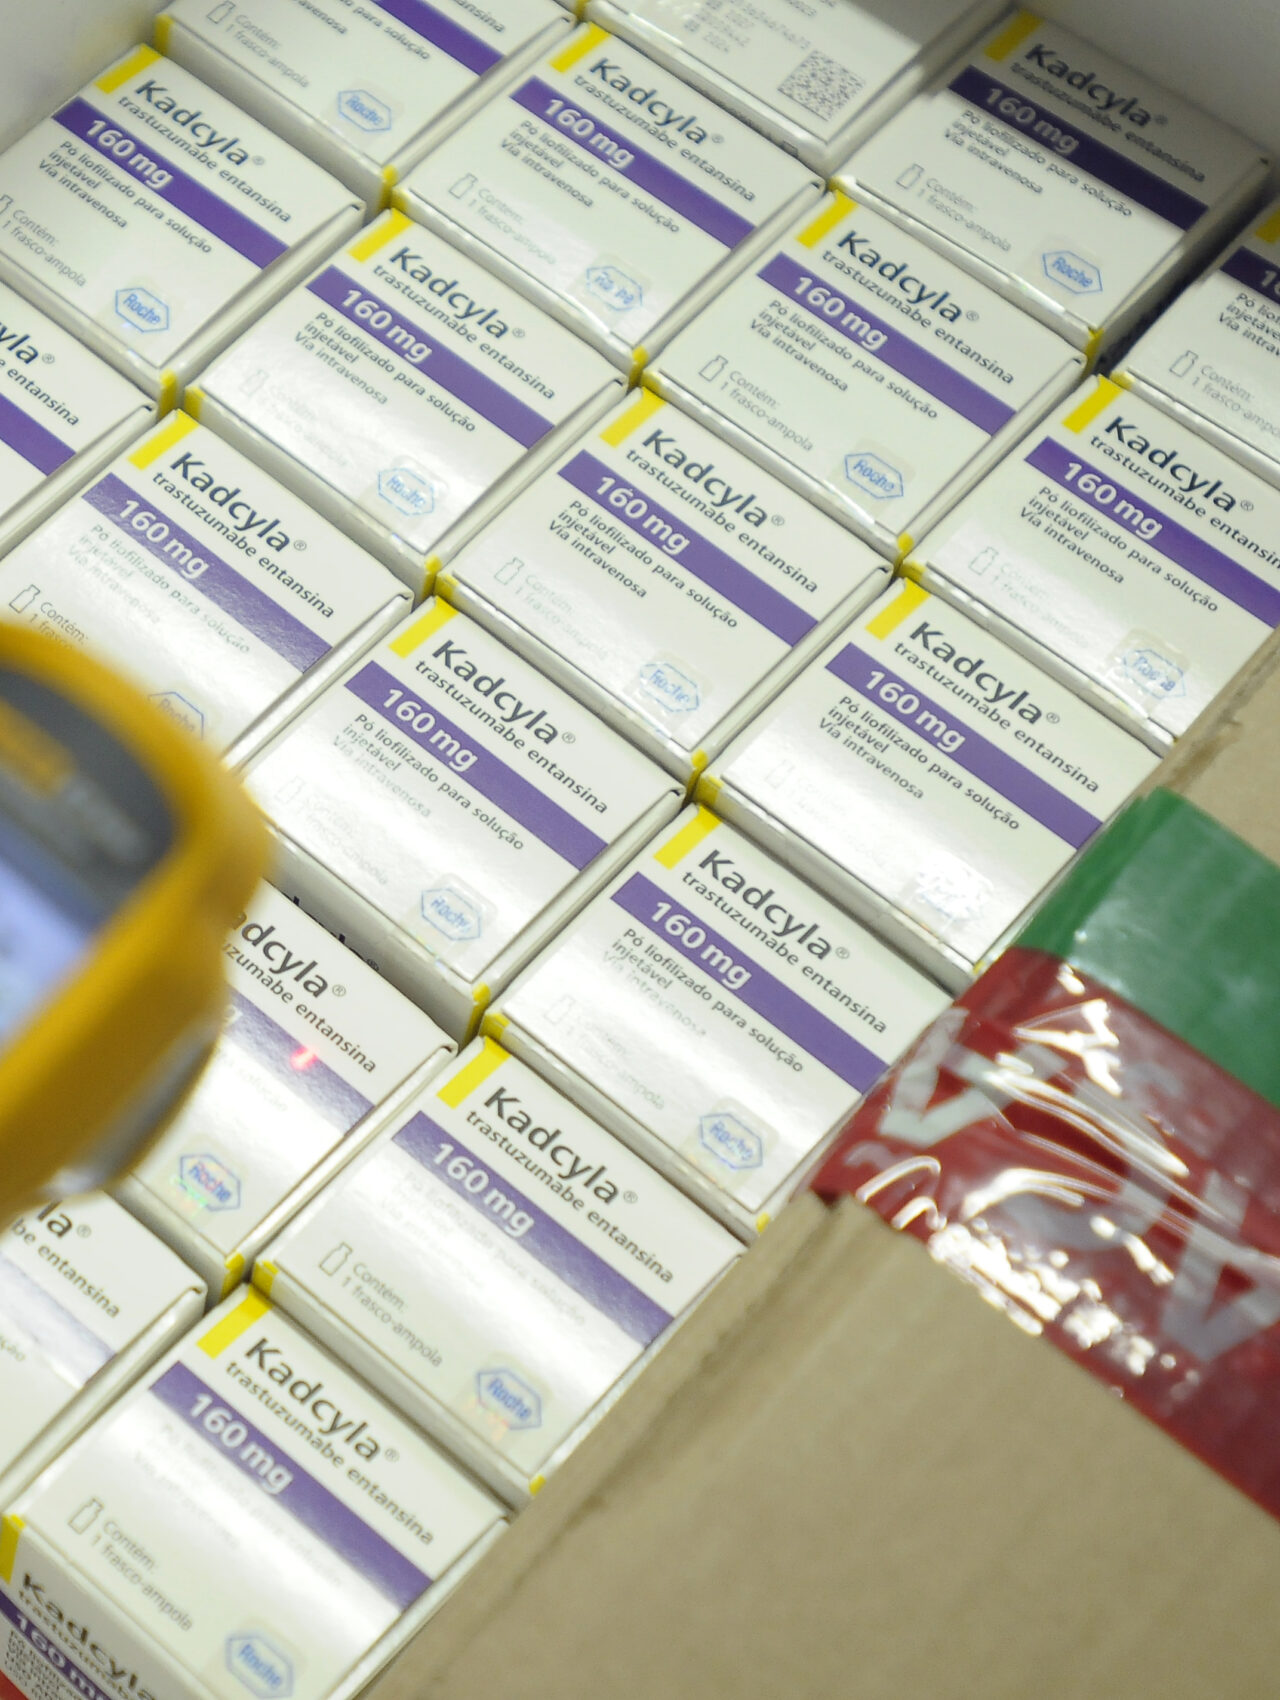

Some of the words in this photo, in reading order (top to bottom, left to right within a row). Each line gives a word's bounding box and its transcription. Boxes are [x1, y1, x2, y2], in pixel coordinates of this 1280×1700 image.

[47, 149, 102, 189] injetável
[87, 120, 136, 157] 160
[127, 153, 173, 189] mg
[119, 97, 218, 170] trastuzumabe
[219, 169, 290, 222] entansina
[545, 98, 595, 137] 160
[588, 132, 635, 169] mg
[573, 75, 677, 149] trastuzumabe
[680, 148, 754, 202] entansina
[38, 159, 57, 178] Via
[57, 174, 127, 229] intravenosa
[59, 141, 78, 156] Pó
[77, 153, 135, 198] liofilizado
[133, 197, 164, 220] para
[164, 218, 211, 254] solução
[632, 198, 681, 234] solução
[341, 289, 392, 329] 160
[385, 325, 432, 364] mg
[372, 265, 477, 343] trastuzumabe
[479, 342, 555, 399] entansina
[793, 276, 845, 316] 160
[839, 311, 888, 350] mg
[821, 249, 931, 328] trastuzumabe
[934, 327, 1014, 384] entansina
[7, 369, 79, 426] entansina
[768, 300, 788, 316] Pó
[788, 313, 852, 361] liofilizado
[852, 359, 884, 383] para
[886, 381, 937, 419] solução
[118, 498, 170, 542] 160
[161, 537, 210, 579] mg
[152, 472, 257, 557] trastuzumabe
[258, 556, 334, 618] entansina
[595, 475, 648, 518] 160
[641, 514, 690, 555] mg
[626, 449, 735, 532] trastuzumabe
[738, 532, 818, 593] entansina
[1063, 462, 1117, 504] 160
[1112, 499, 1162, 540] mg
[1090, 436, 1205, 517] trastuzumabe
[1209, 516, 1280, 576] entansina
[569, 500, 589, 517] Pó
[588, 514, 652, 565] liofilizado
[651, 564, 685, 590] para
[686, 588, 738, 628] solução
[1164, 572, 1219, 613] solução
[382, 688, 436, 734] 160
[428, 729, 478, 772] mg
[415, 660, 525, 749] trastuzumabe
[527, 749, 607, 813] entansina
[865, 670, 920, 715] 160
[914, 710, 965, 753] mg
[894, 642, 1011, 729] trastuzumabe
[1014, 729, 1099, 793] entansina
[838, 696, 859, 713] Pó
[859, 710, 927, 764] liofilizado
[927, 763, 963, 790] para
[964, 788, 1020, 831] solução
[234, 915, 347, 998] dcyla®
[651, 901, 706, 949] 160
[699, 944, 751, 990] mg
[682, 871, 799, 965] trastuzumabe
[802, 965, 886, 1033] entansina
[295, 1003, 377, 1073] entansina
[711, 1000, 747, 1029] para
[748, 1027, 803, 1073] solução
[430, 1141, 488, 1192] 160
[480, 1187, 534, 1236] mg
[466, 1110, 584, 1210] trastuzumabe
[586, 1210, 672, 1282] entansina
[38, 1245, 119, 1316] entansina
[188, 1392, 247, 1446] 160
[237, 1441, 292, 1493] mg
[225, 1360, 344, 1467] trastuzumabe
[347, 1467, 434, 1545] entansina
